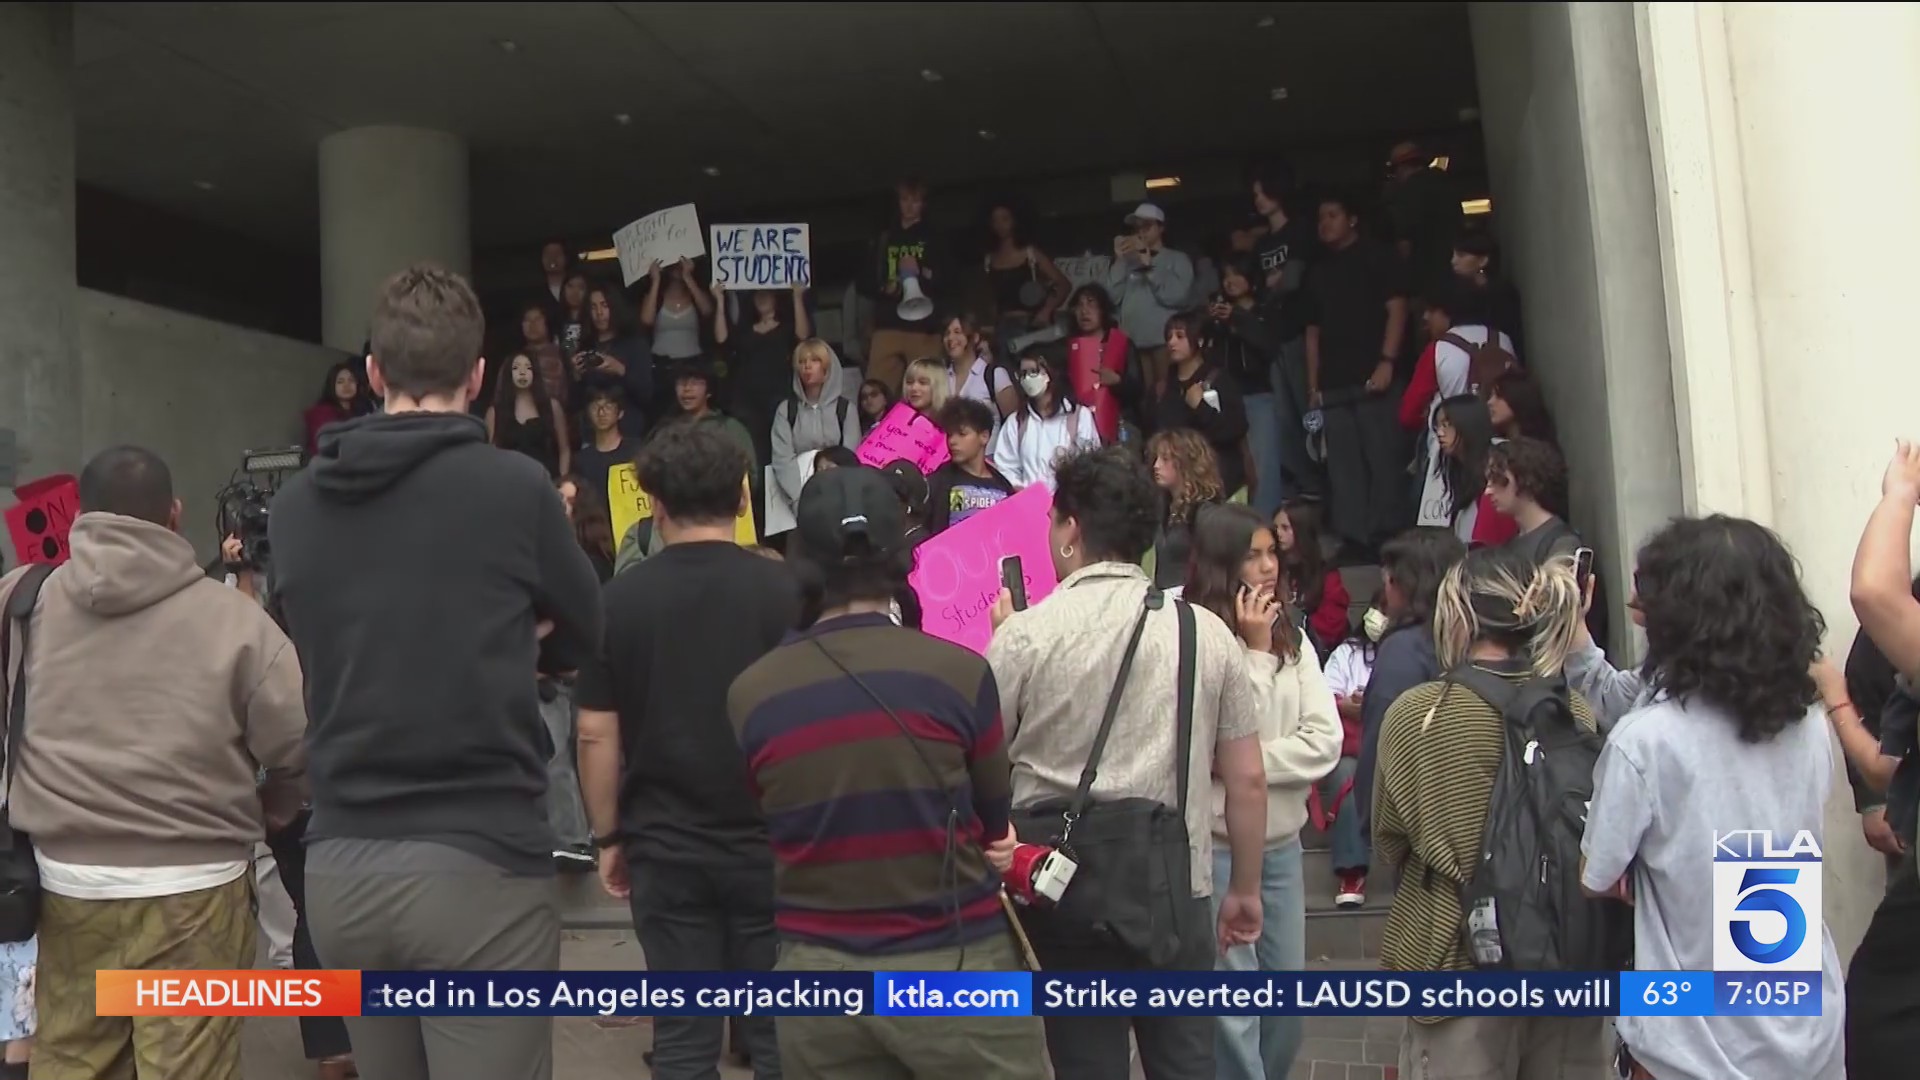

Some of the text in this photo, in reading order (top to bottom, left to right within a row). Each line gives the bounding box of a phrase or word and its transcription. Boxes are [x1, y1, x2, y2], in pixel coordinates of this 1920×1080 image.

[715, 227, 802, 254] WE ARE
[715, 253, 810, 286] STUDENTS
